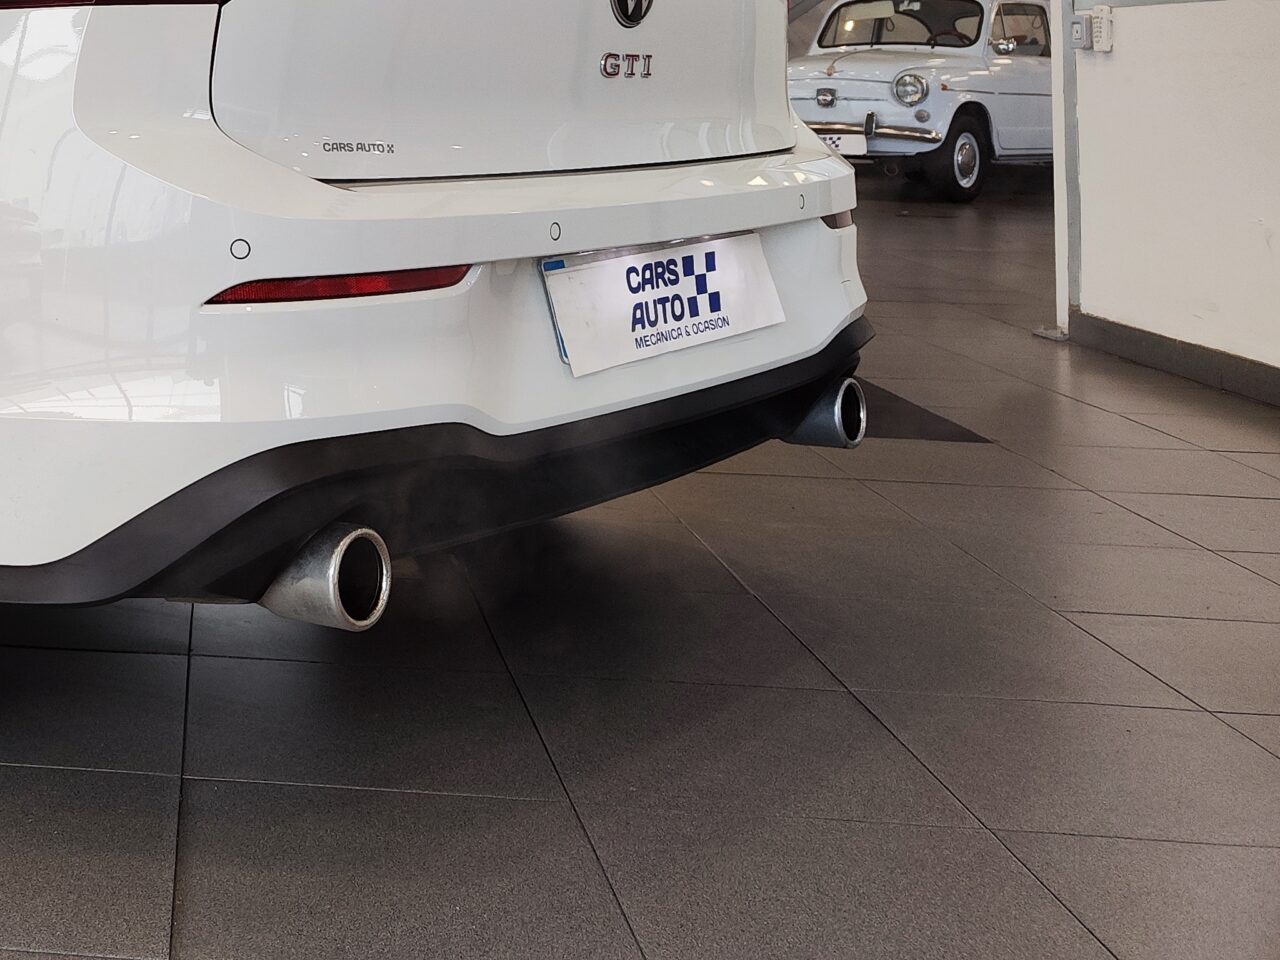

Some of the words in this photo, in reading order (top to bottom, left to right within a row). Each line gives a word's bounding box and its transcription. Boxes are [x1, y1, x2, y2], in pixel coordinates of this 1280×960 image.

[600, 52, 653, 79] GTI
[322, 142, 354, 152] CARS
[356, 142, 385, 153] AUTO
[626, 258, 680, 294] CARS
[631, 293, 686, 333] AUTO
[634, 327, 683, 350] MECÁNICA
[684, 325, 691, 337] &
[691, 314, 730, 335] OCASIÓN
